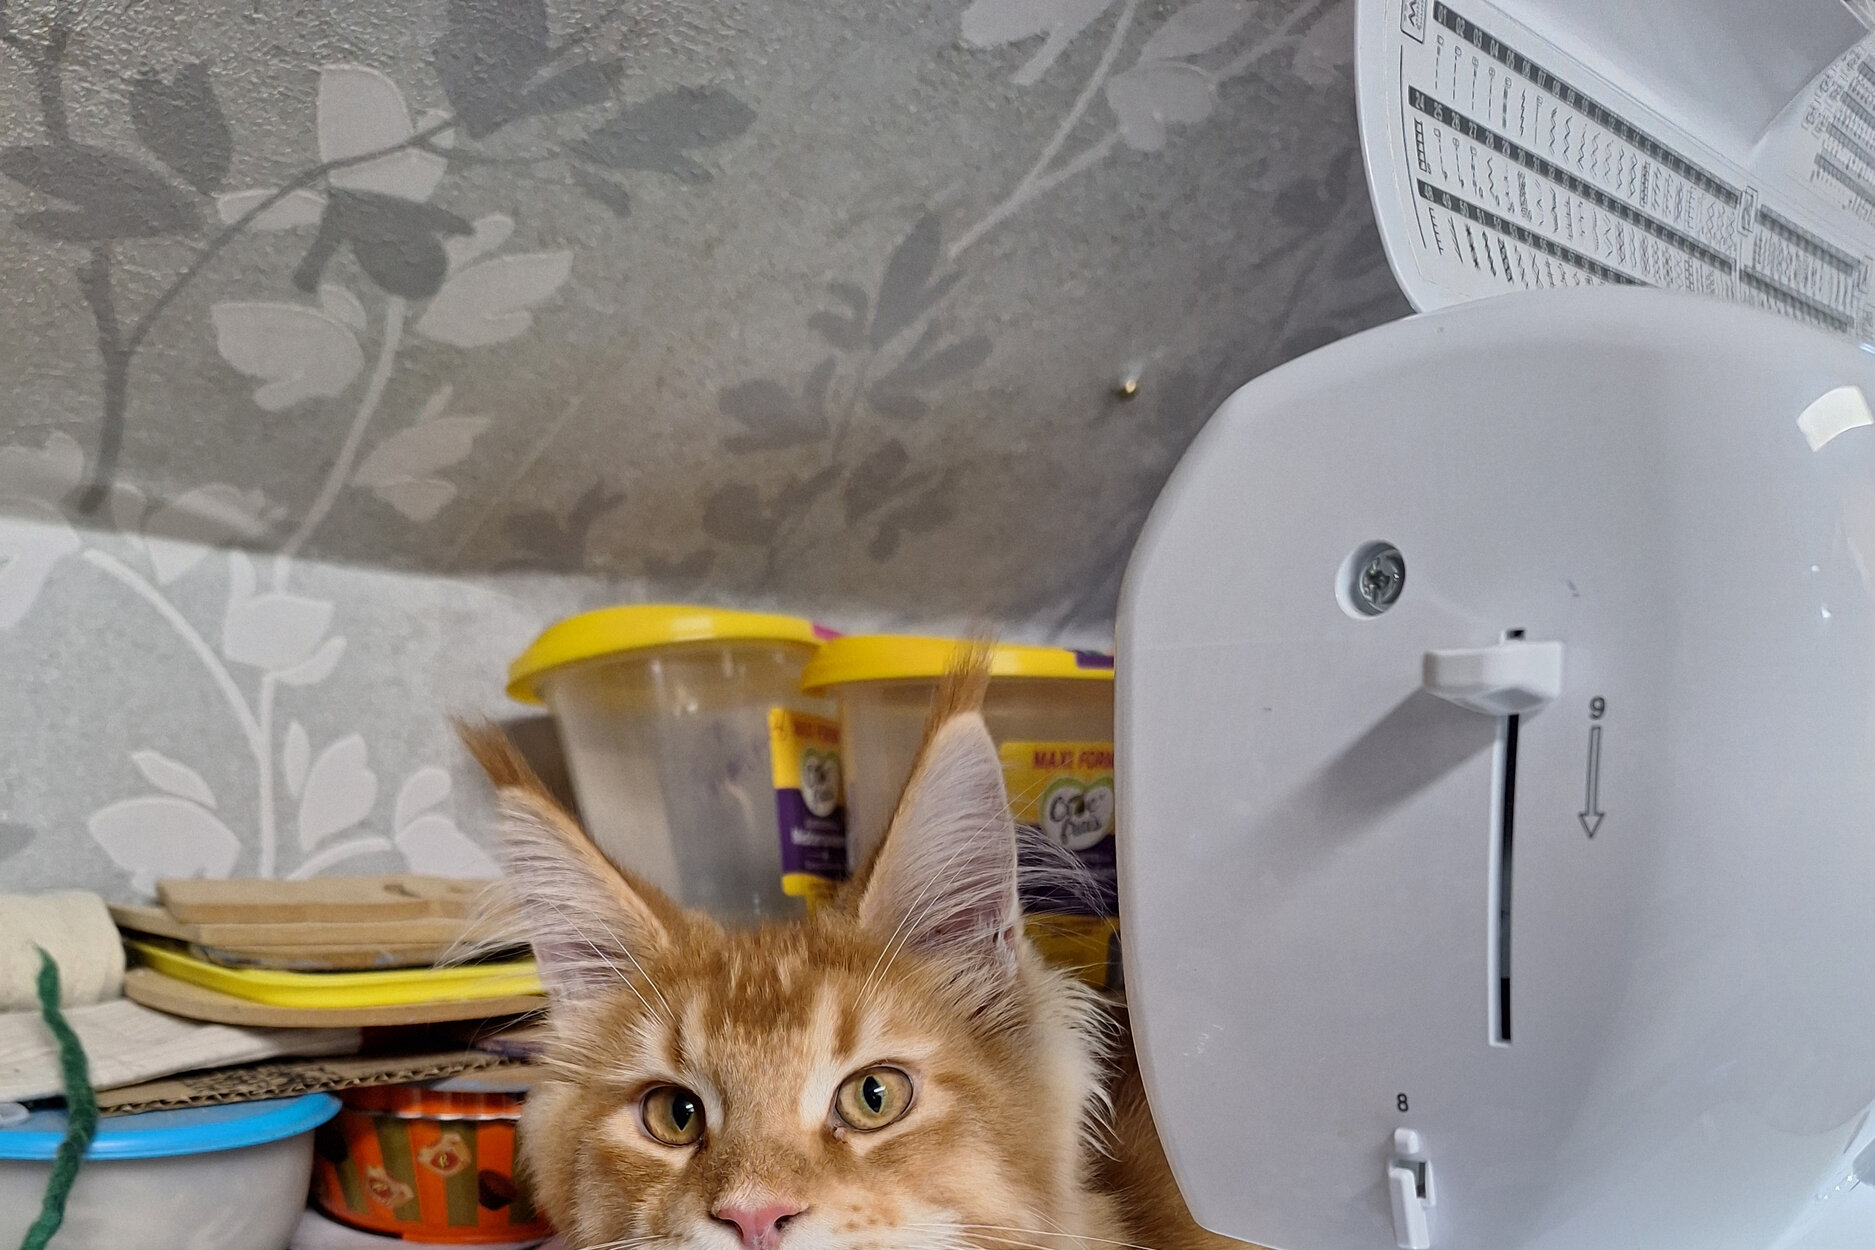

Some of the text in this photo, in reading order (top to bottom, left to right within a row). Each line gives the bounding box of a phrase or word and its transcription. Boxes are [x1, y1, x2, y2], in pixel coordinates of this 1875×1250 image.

[1438, 5, 1447, 26] 01
[1456, 17, 1465, 38] 02
[1473, 28, 1483, 49] 03
[1490, 39, 1499, 59] 04
[1506, 50, 1515, 70] 05
[1538, 69, 1546, 88] 07
[1416, 91, 1425, 112] 24
[1434, 101, 1443, 122] 25
[1451, 111, 1461, 131] 26
[1468, 121, 1477, 140] 27
[1424, 183, 1434, 201] 48
[1460, 201, 1469, 219] 50
[1476, 208, 1486, 226] 51
[1589, 696, 1606, 720] 9
[1397, 1093, 1409, 1112] 8
